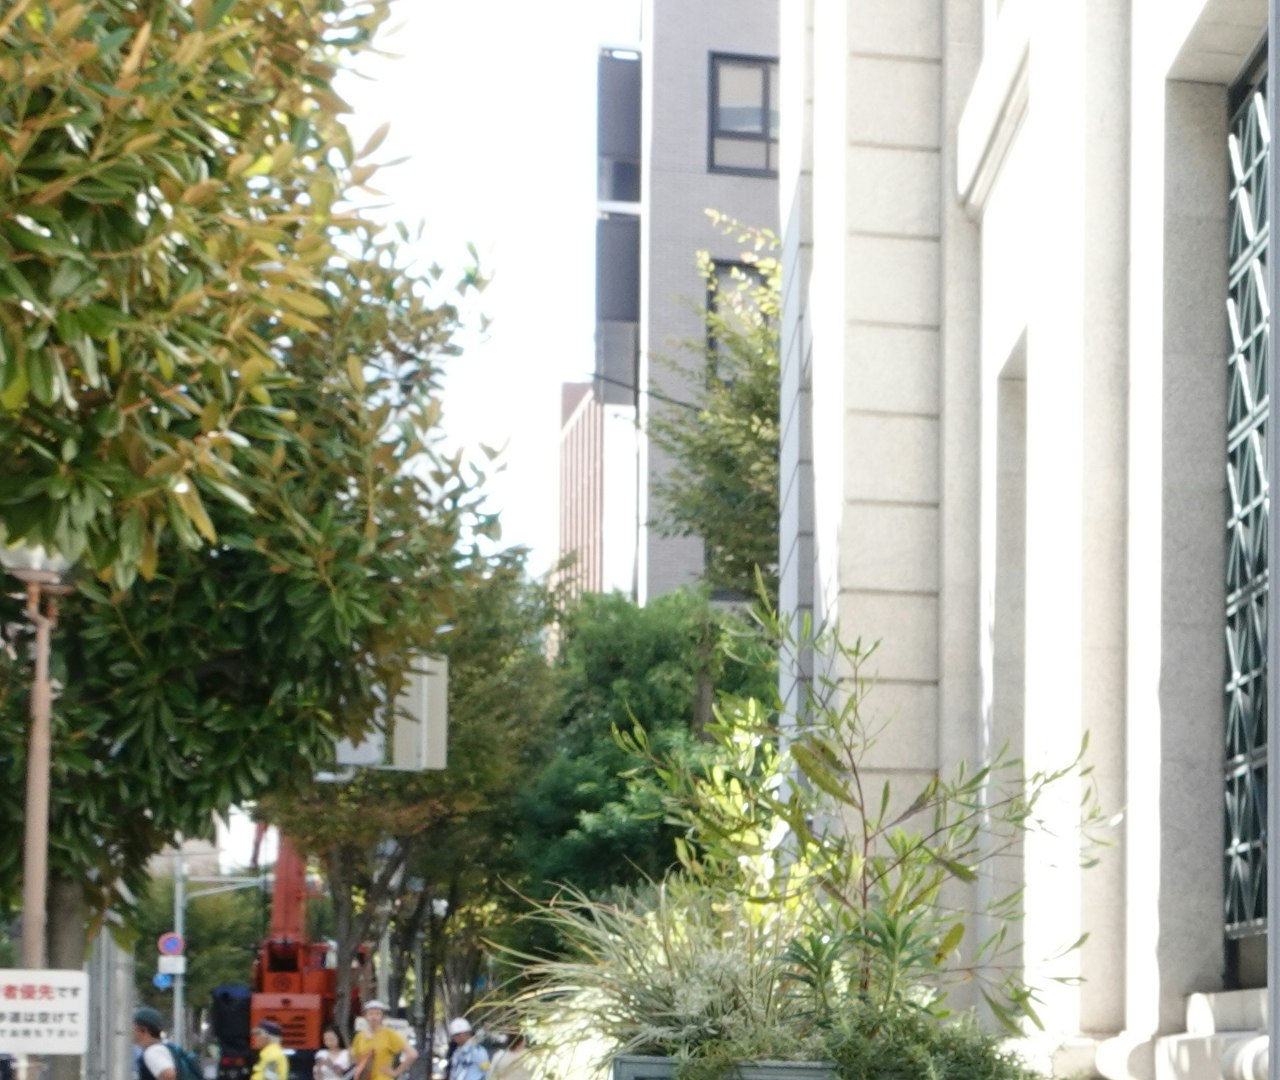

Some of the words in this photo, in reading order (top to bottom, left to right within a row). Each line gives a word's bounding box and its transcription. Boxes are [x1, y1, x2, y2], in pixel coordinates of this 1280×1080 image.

[0, 985, 81, 1000] 者優先です
